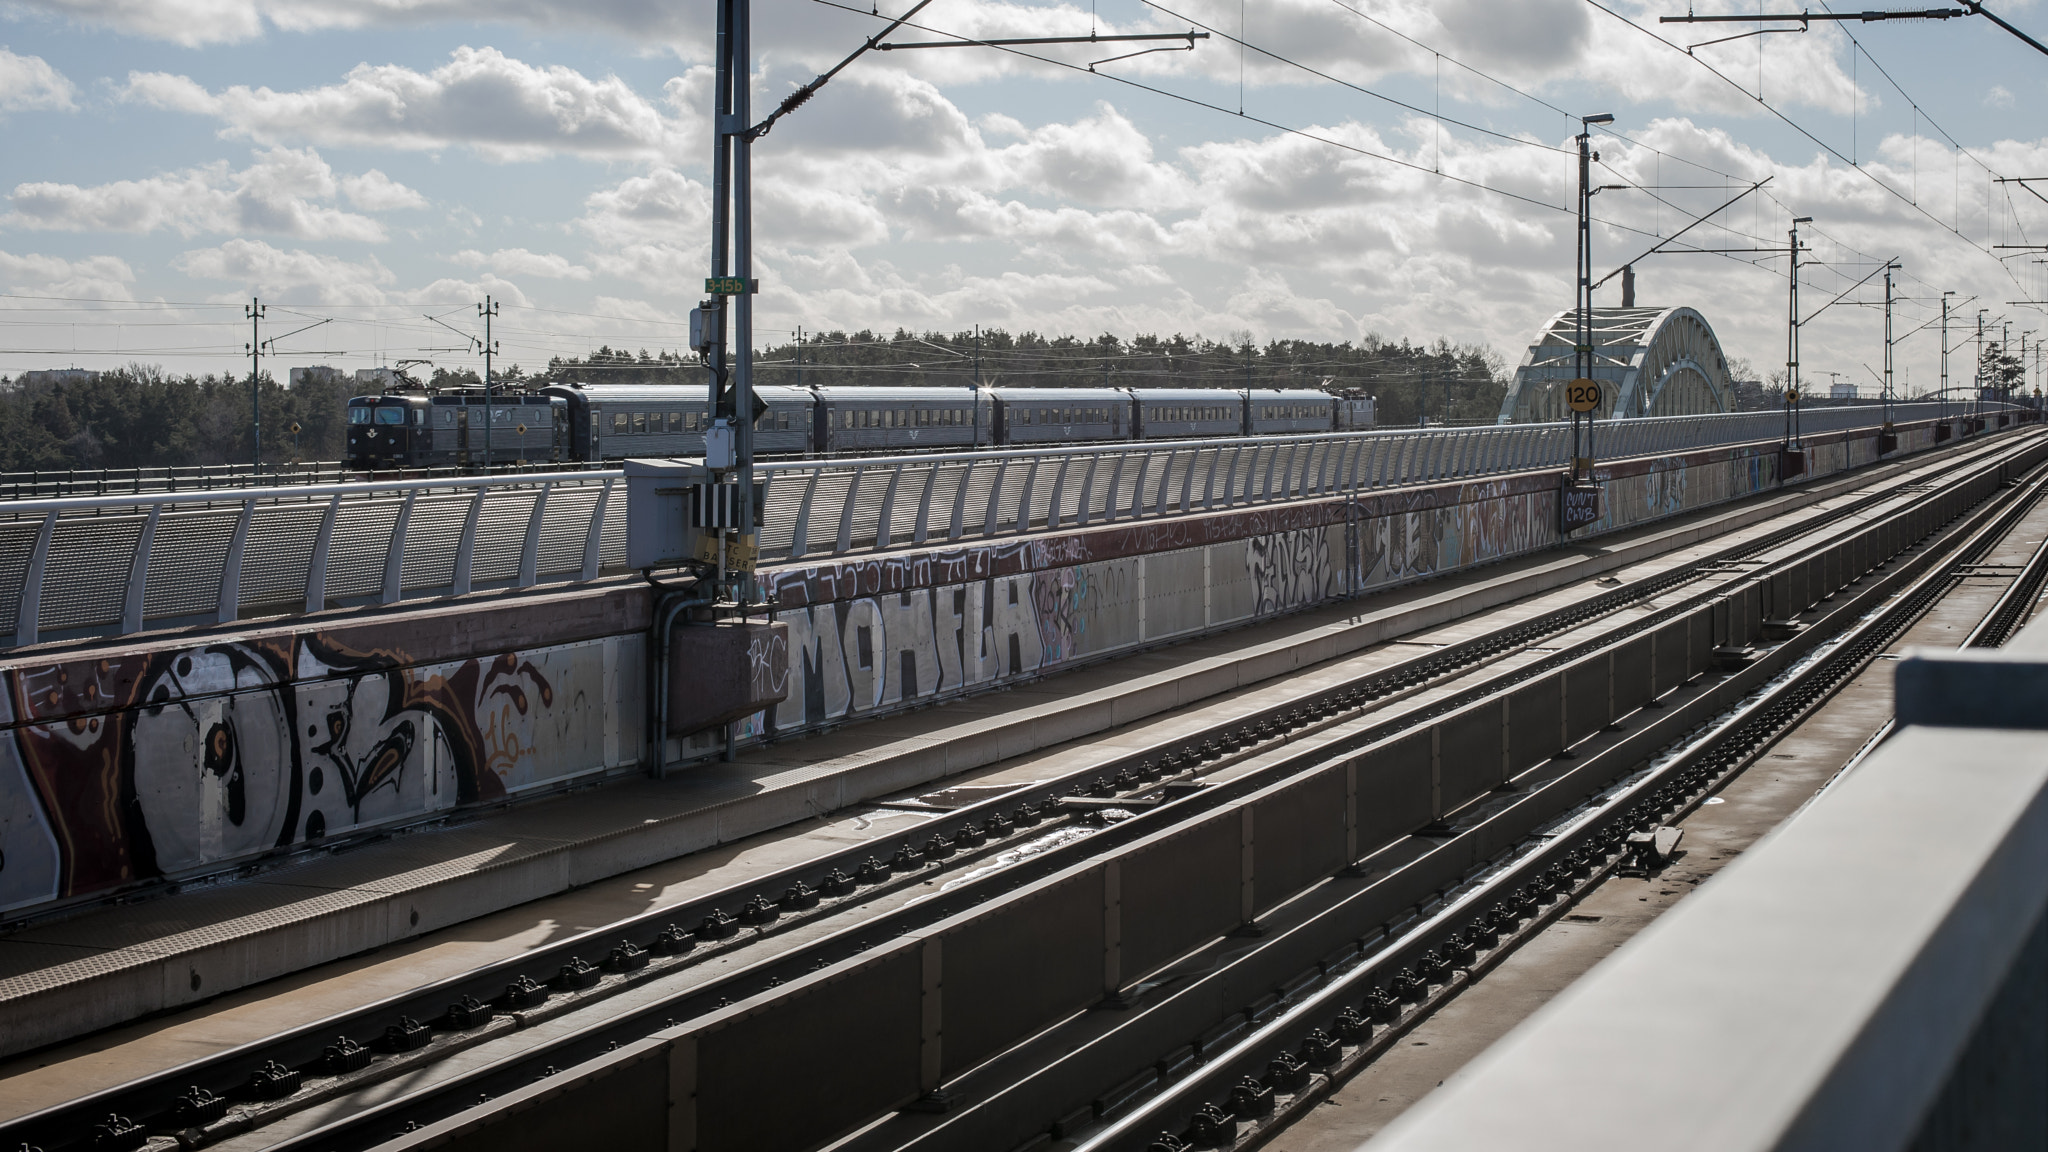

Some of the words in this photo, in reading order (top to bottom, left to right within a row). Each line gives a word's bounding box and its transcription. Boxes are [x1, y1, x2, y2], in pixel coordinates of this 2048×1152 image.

[707, 279, 743, 292] 3-15b
[1566, 386, 1599, 403] 120
[1566, 491, 1597, 506] CUNT
[704, 552, 748, 569] BASER
